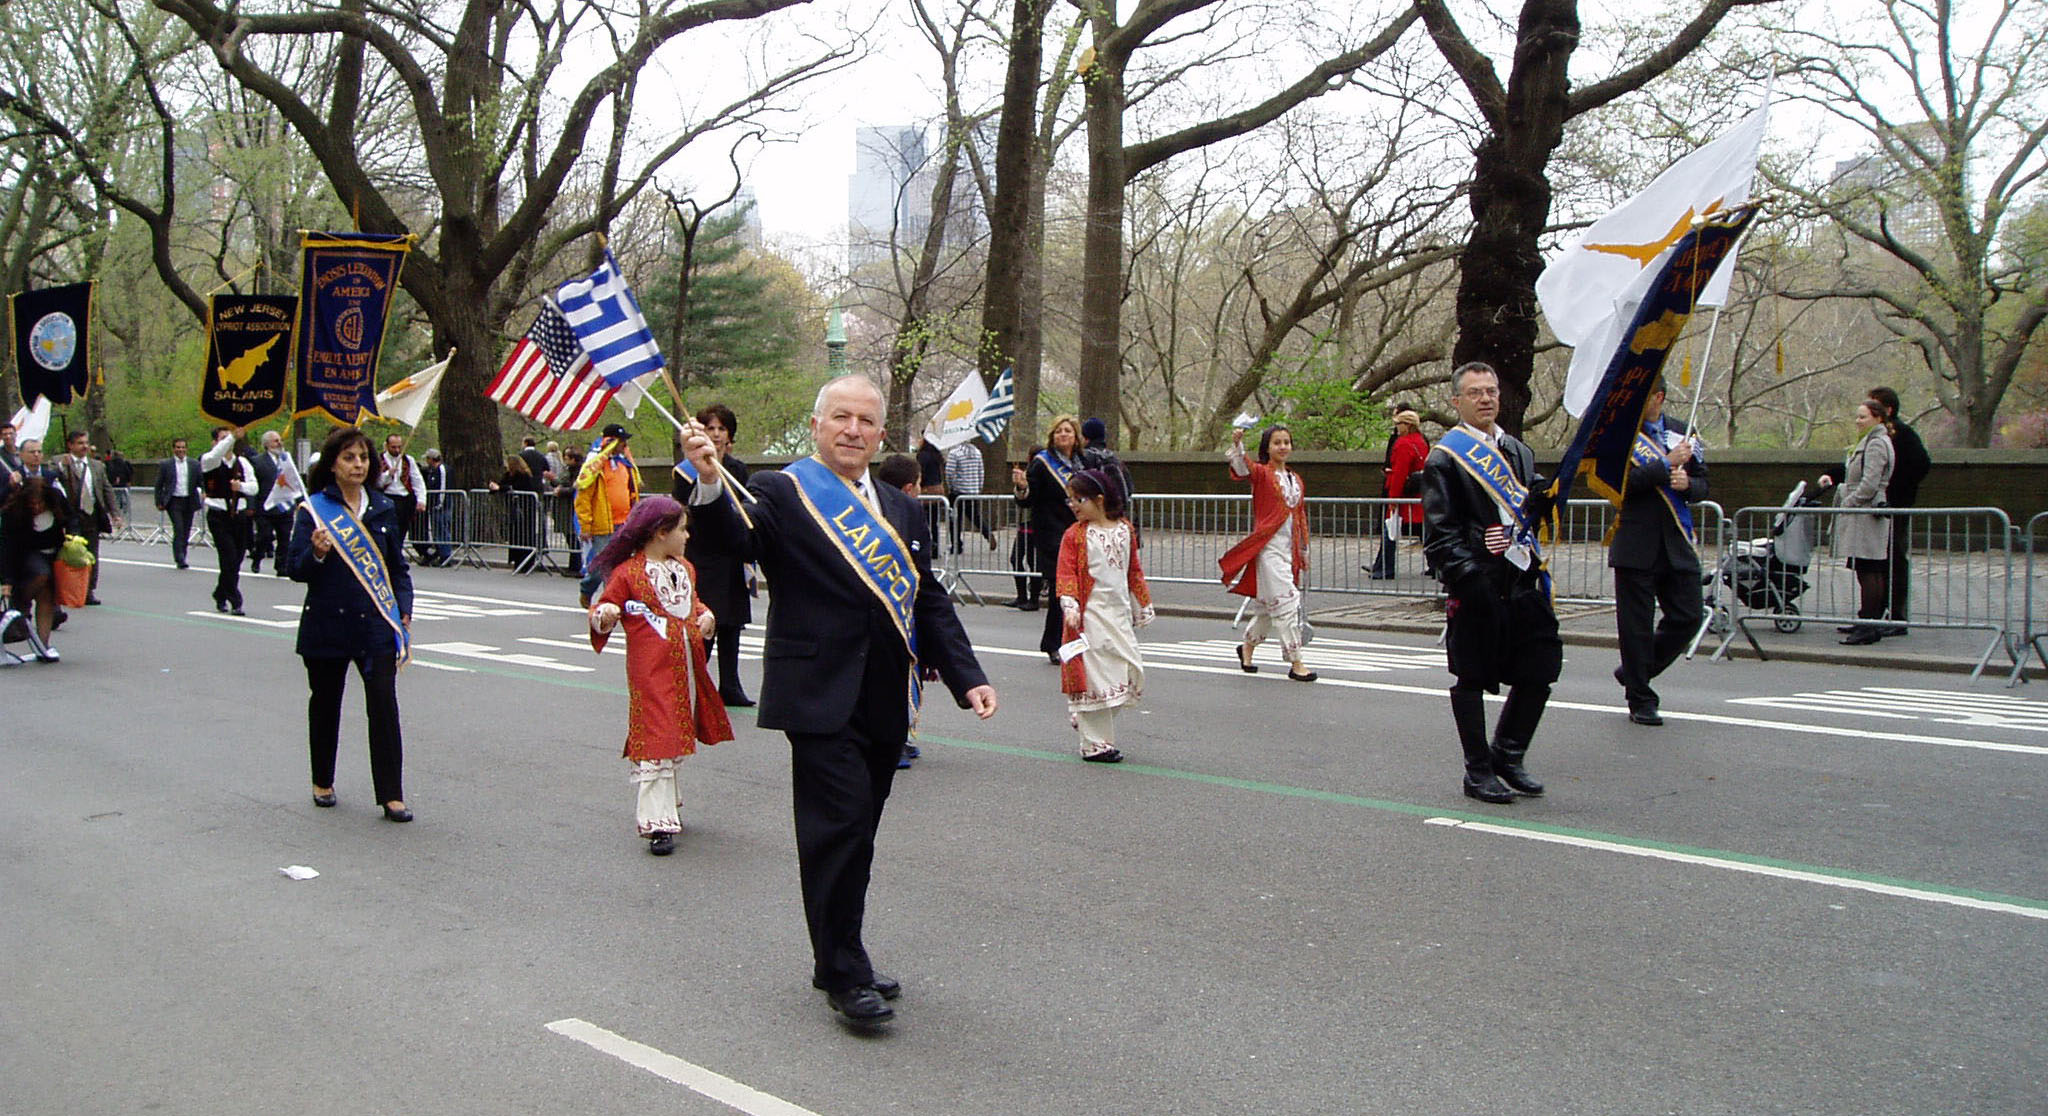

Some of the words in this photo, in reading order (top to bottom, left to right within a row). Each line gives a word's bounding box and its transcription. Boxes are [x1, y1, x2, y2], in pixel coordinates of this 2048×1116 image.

[219, 304, 245, 320] NEW
[249, 303, 288, 322] JERSEY
[246, 321, 291, 331] ASSOCIATION
[214, 389, 274, 400] SALAMIS
[329, 514, 394, 612] LAMPOUSA
